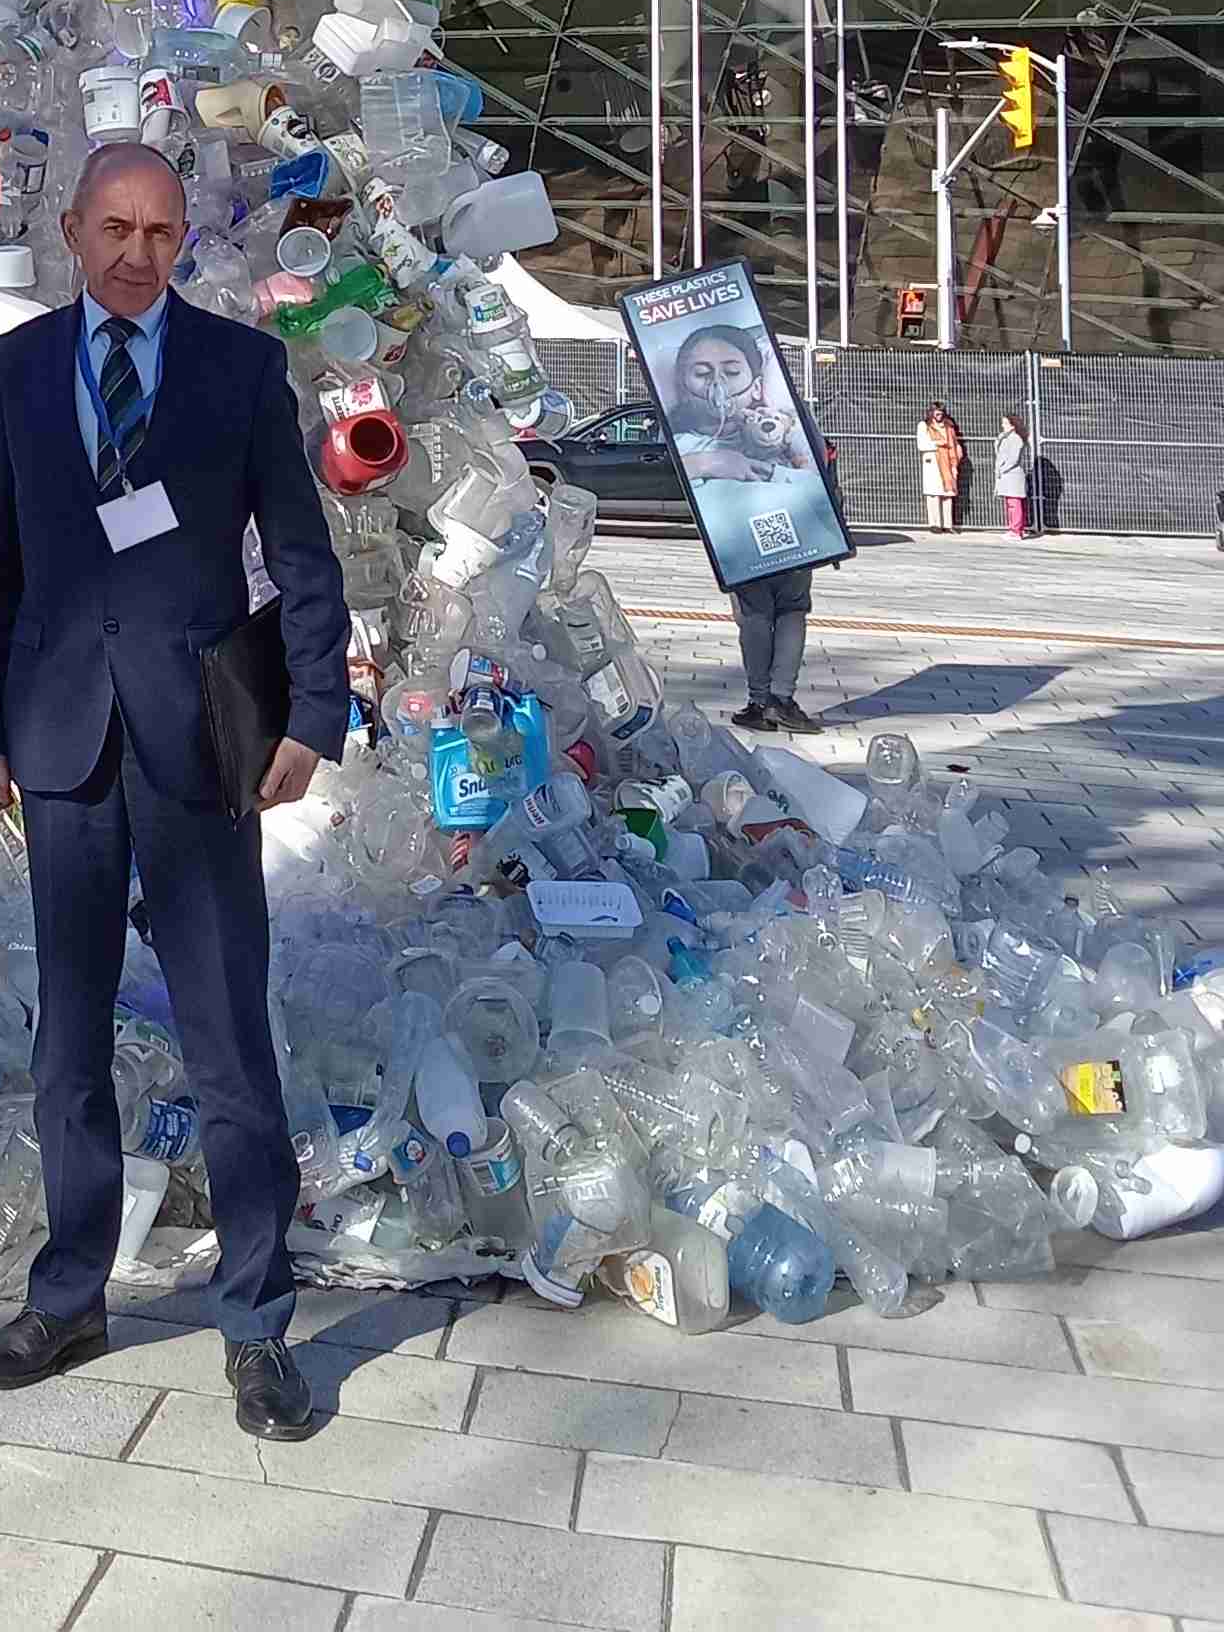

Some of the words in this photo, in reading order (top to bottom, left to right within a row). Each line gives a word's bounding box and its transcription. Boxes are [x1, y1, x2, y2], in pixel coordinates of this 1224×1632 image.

[632, 287, 672, 307] THESE
[671, 271, 727, 294] PLASTICS
[639, 299, 688, 325] SAVE
[687, 283, 741, 311] LIVES
